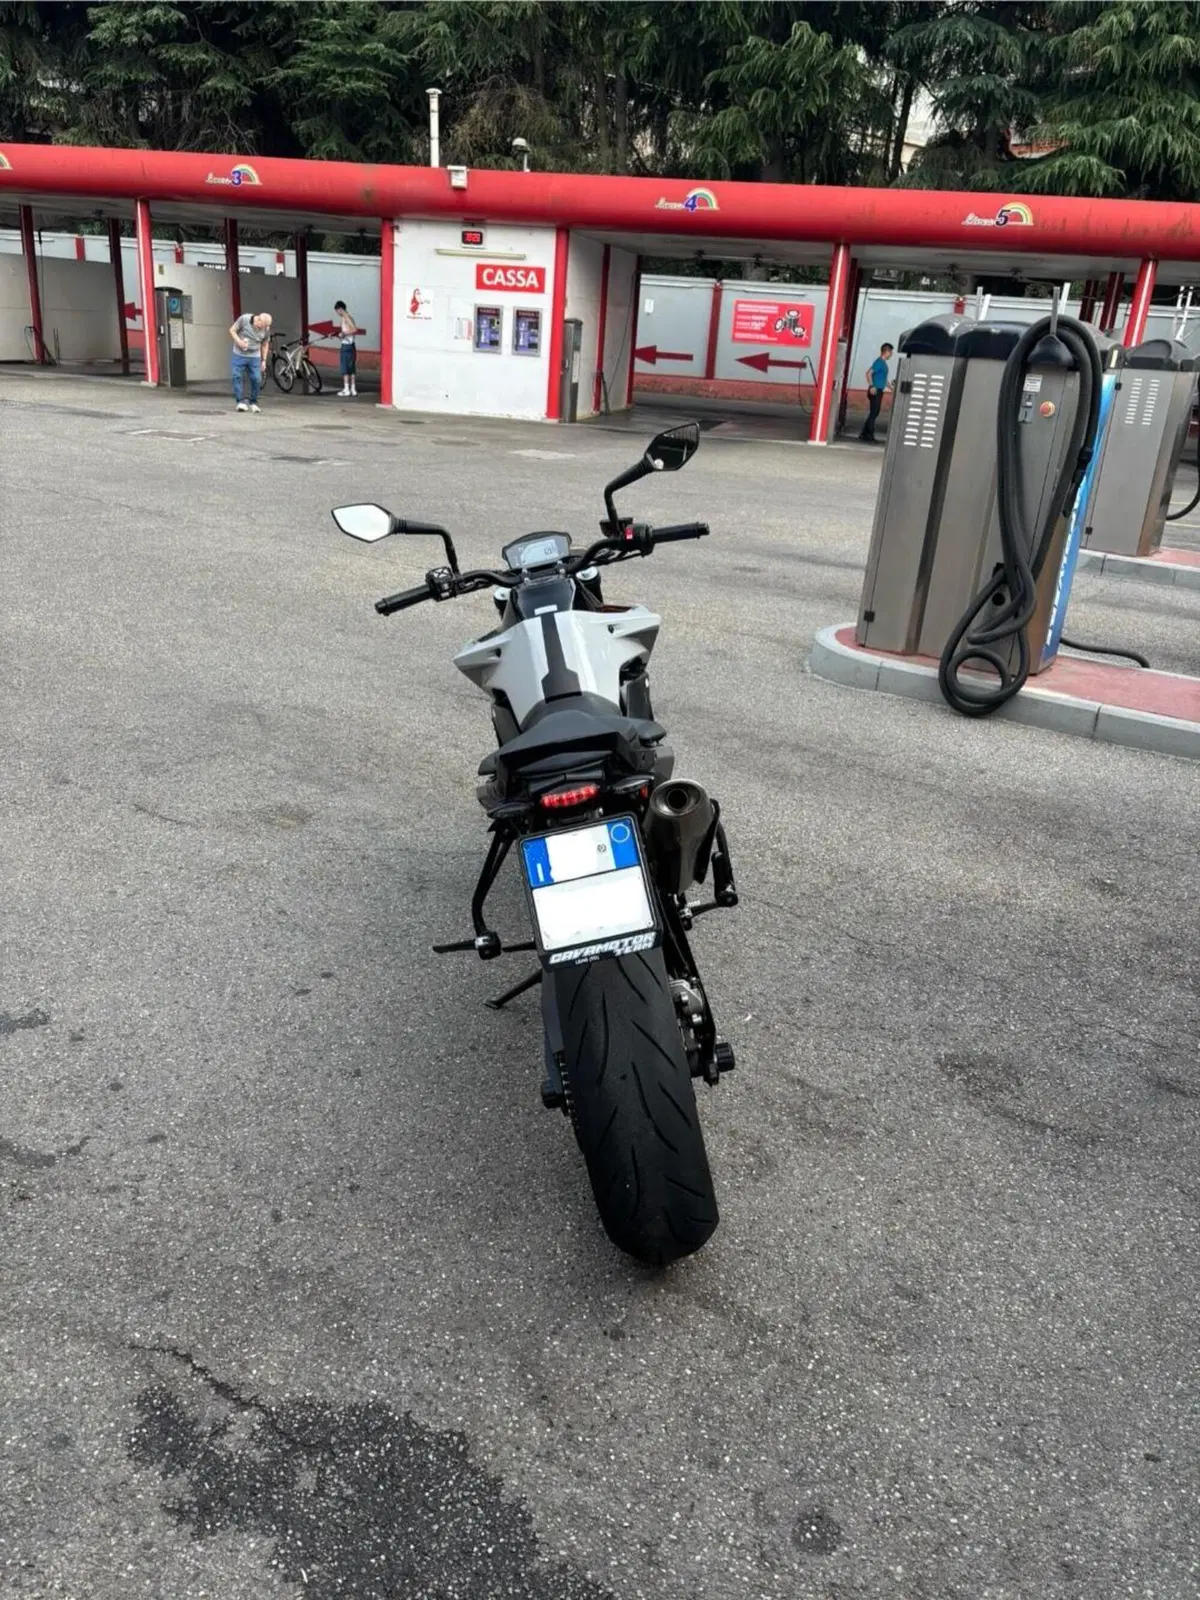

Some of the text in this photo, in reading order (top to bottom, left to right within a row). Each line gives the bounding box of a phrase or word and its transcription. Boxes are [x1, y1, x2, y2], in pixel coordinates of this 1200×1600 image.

[231, 170, 242, 186] 3
[684, 194, 698, 212] 4
[995, 208, 1011, 227] 5
[482, 267, 540, 289] CASSA
[548, 931, 657, 965] CAVAMOTOR
[613, 943, 654, 957] TEAM
